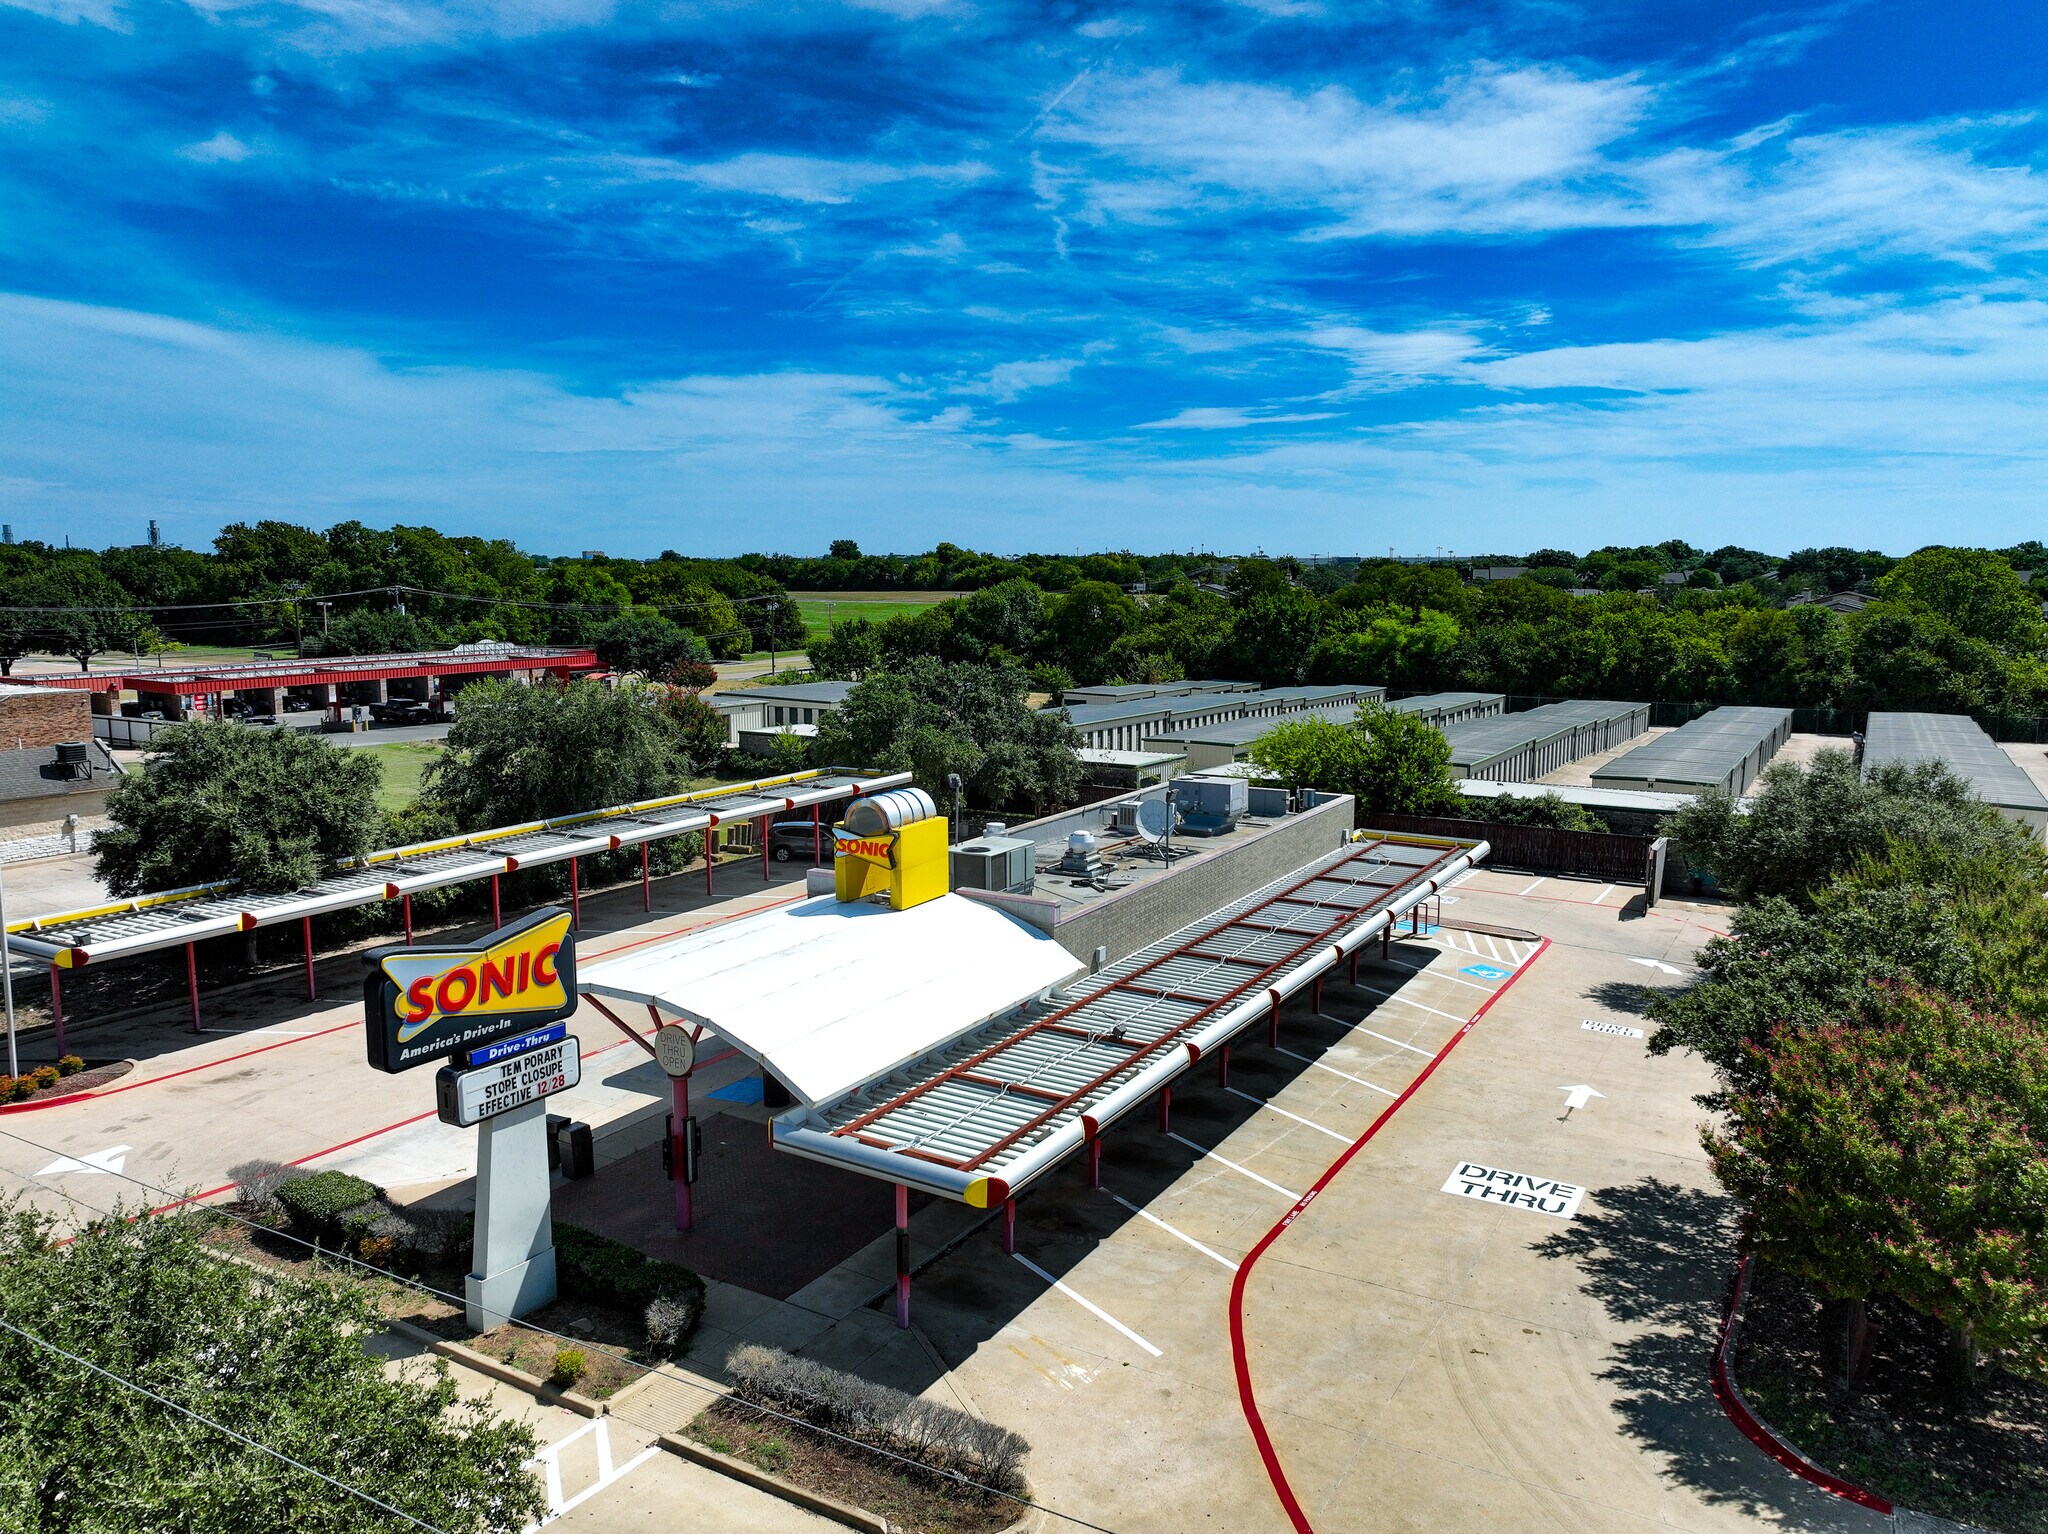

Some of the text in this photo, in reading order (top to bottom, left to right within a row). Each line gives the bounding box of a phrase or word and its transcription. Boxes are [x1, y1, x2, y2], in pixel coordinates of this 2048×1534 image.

[837, 838, 890, 858] SONIC
[403, 943, 561, 1025] SONIC
[400, 1033, 461, 1061] America's
[660, 1031, 686, 1046] DRIVE
[662, 1044, 686, 1058] THRU
[662, 1056, 686, 1069] OPEN
[479, 1074, 565, 1117] EFFECTIVE 12/28
[1459, 1164, 1576, 1199] DRIVE
[1460, 1180, 1566, 1213] THRU
